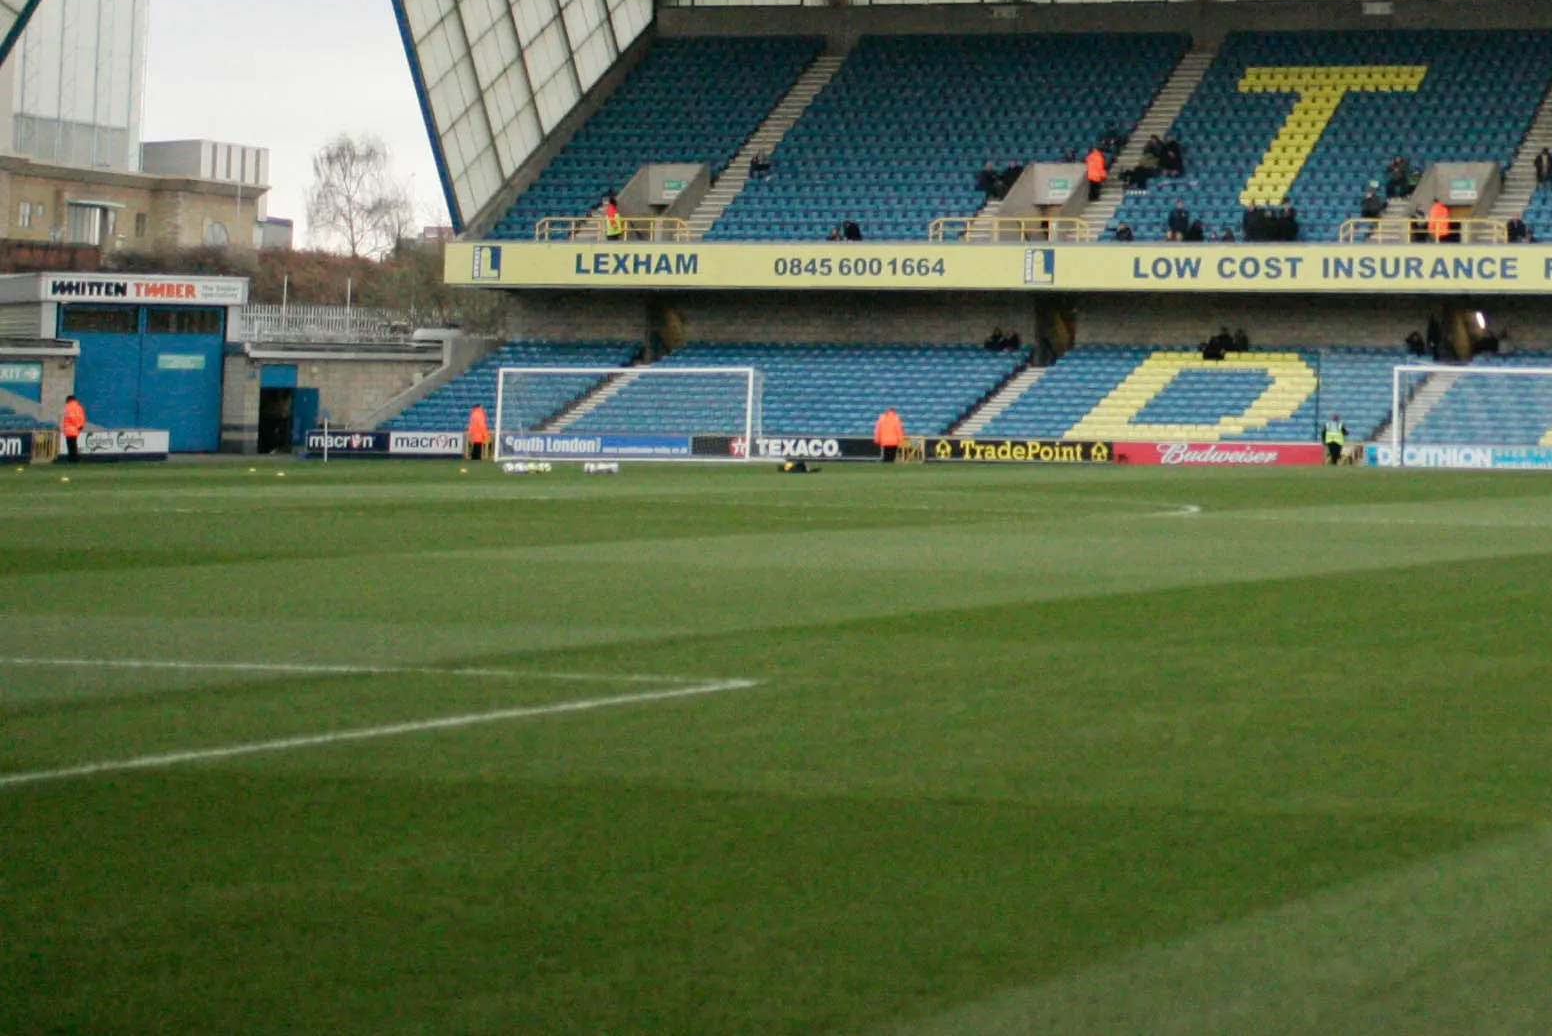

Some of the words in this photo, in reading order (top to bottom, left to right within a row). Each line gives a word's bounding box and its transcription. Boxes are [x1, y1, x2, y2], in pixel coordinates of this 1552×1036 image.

[574, 252, 699, 277] LEXHAM
[773, 257, 833, 278] 0845
[838, 257, 883, 278] 600
[889, 257, 946, 278] 1664
[1132, 256, 1201, 279] LOW
[1216, 256, 1303, 280] COST
[1321, 256, 1518, 281] INSURANCE
[51, 280, 127, 297] WHITTEN
[134, 282, 197, 299] TIMBER
[394, 434, 458, 449] macron
[755, 438, 839, 456] TEXACO
[959, 440, 1082, 462] TradePoint
[1156, 442, 1278, 465] Budweiser
